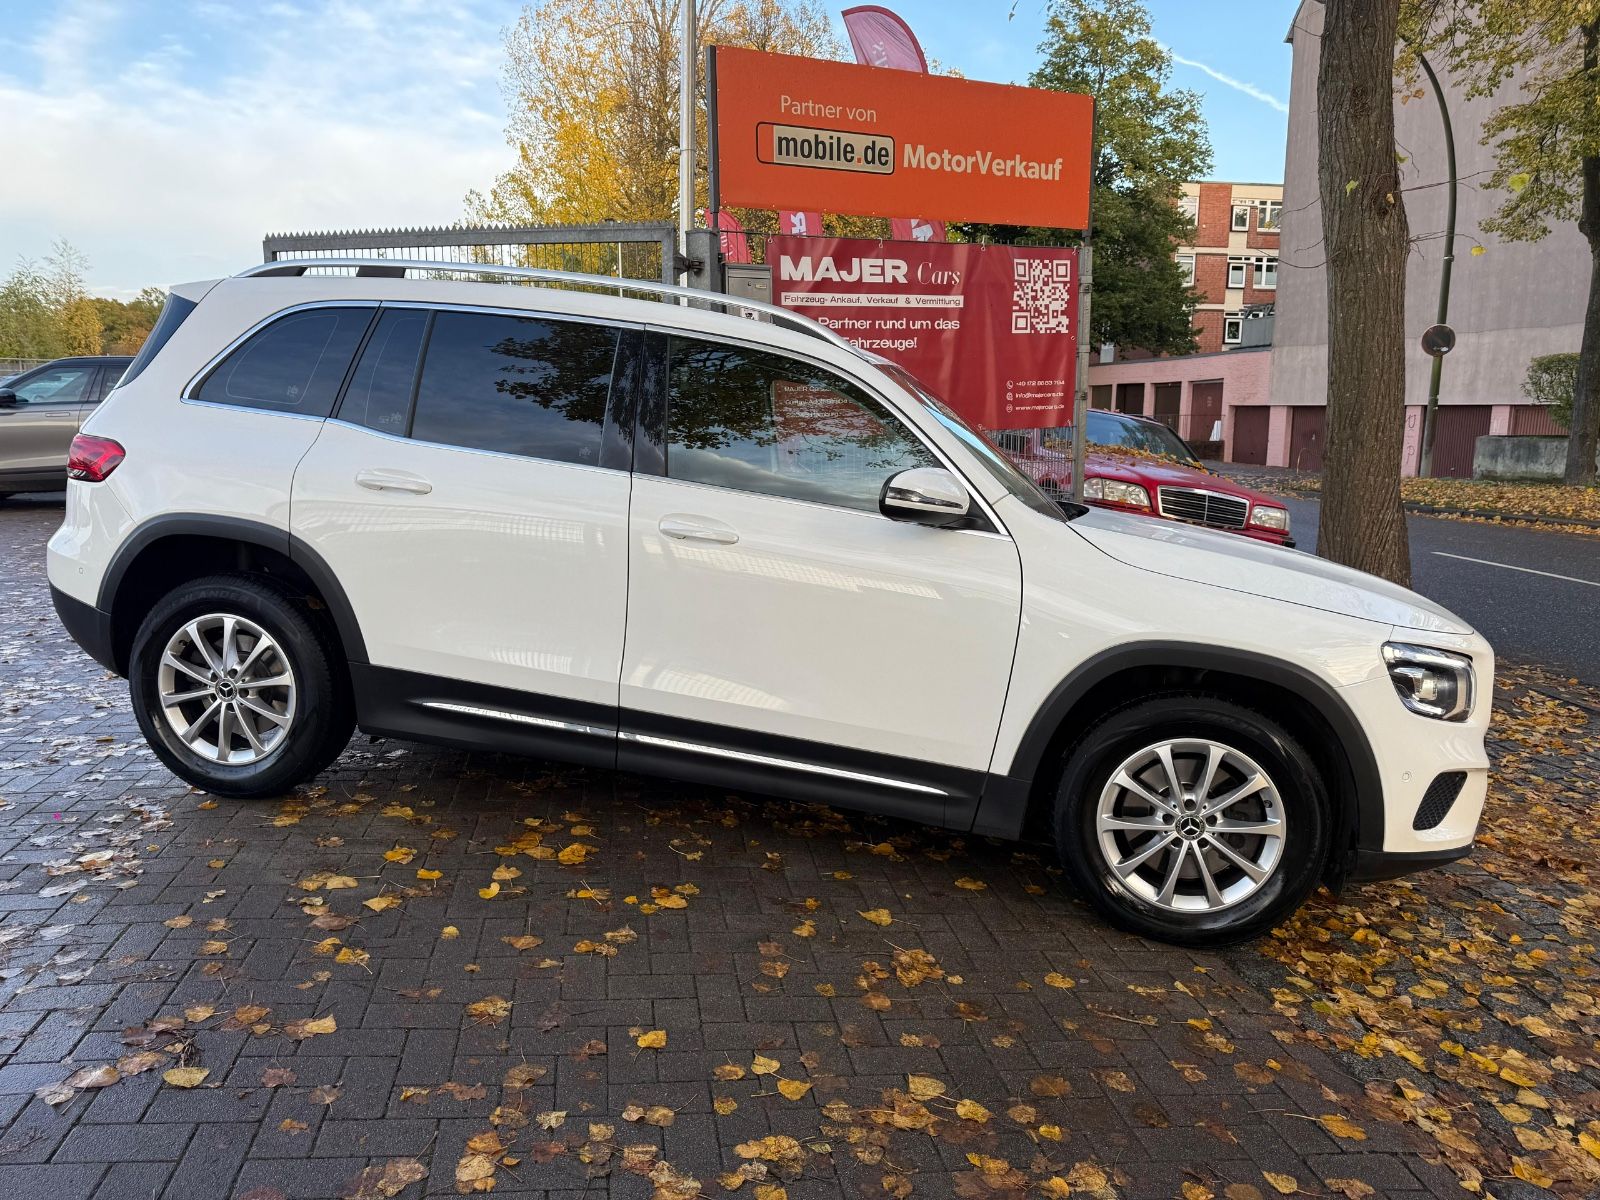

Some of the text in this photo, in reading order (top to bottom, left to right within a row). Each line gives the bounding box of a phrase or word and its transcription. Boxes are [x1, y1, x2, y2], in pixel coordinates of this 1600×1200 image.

[780, 94, 877, 123] Partner von
[777, 133, 1064, 181] mobile.de MotorVerkauf
[780, 255, 961, 286] MAJER Cars
[784, 294, 828, 305] Fahrzeug-
[866, 296, 899, 305] Verkauf
[904, 297, 912, 305] &
[915, 296, 961, 307] Vermittlung
[817, 316, 961, 331] Partner rund um das
[842, 336, 918, 351] ahrzeuge!
